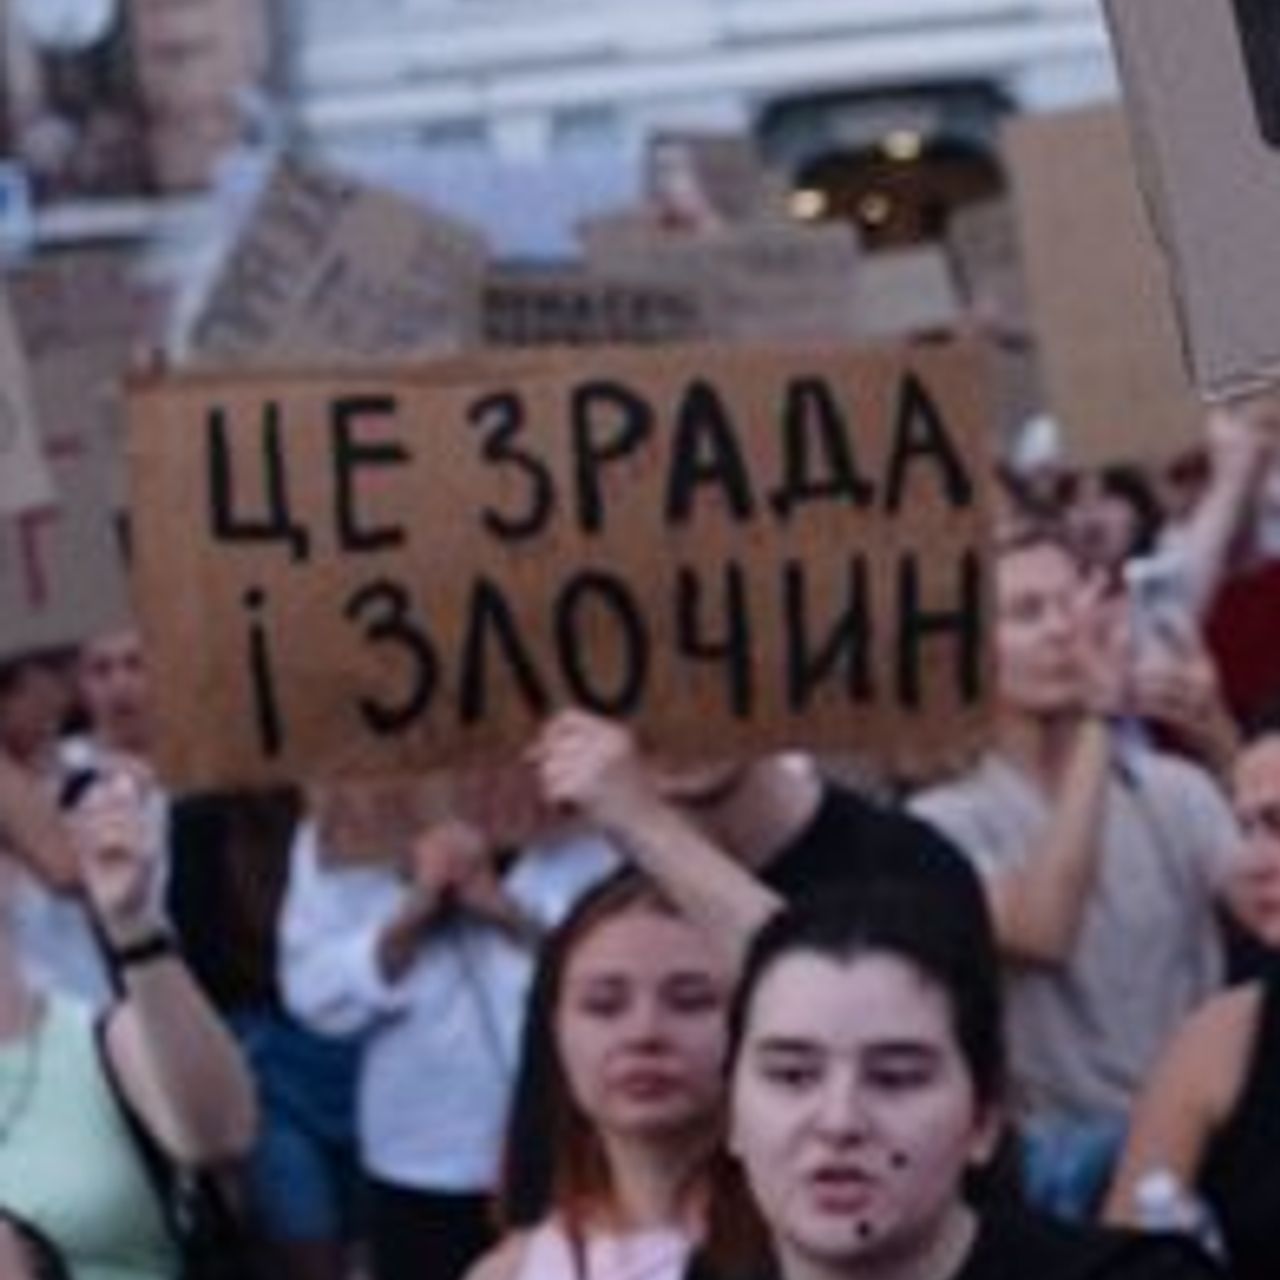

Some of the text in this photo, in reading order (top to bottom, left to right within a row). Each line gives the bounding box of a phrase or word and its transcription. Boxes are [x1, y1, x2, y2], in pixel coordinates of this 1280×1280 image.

[208, 394, 412, 561] ЦЕ
[468, 372, 974, 541] ЗРАДА
[345, 553, 985, 723] ЗЛОЧИН
